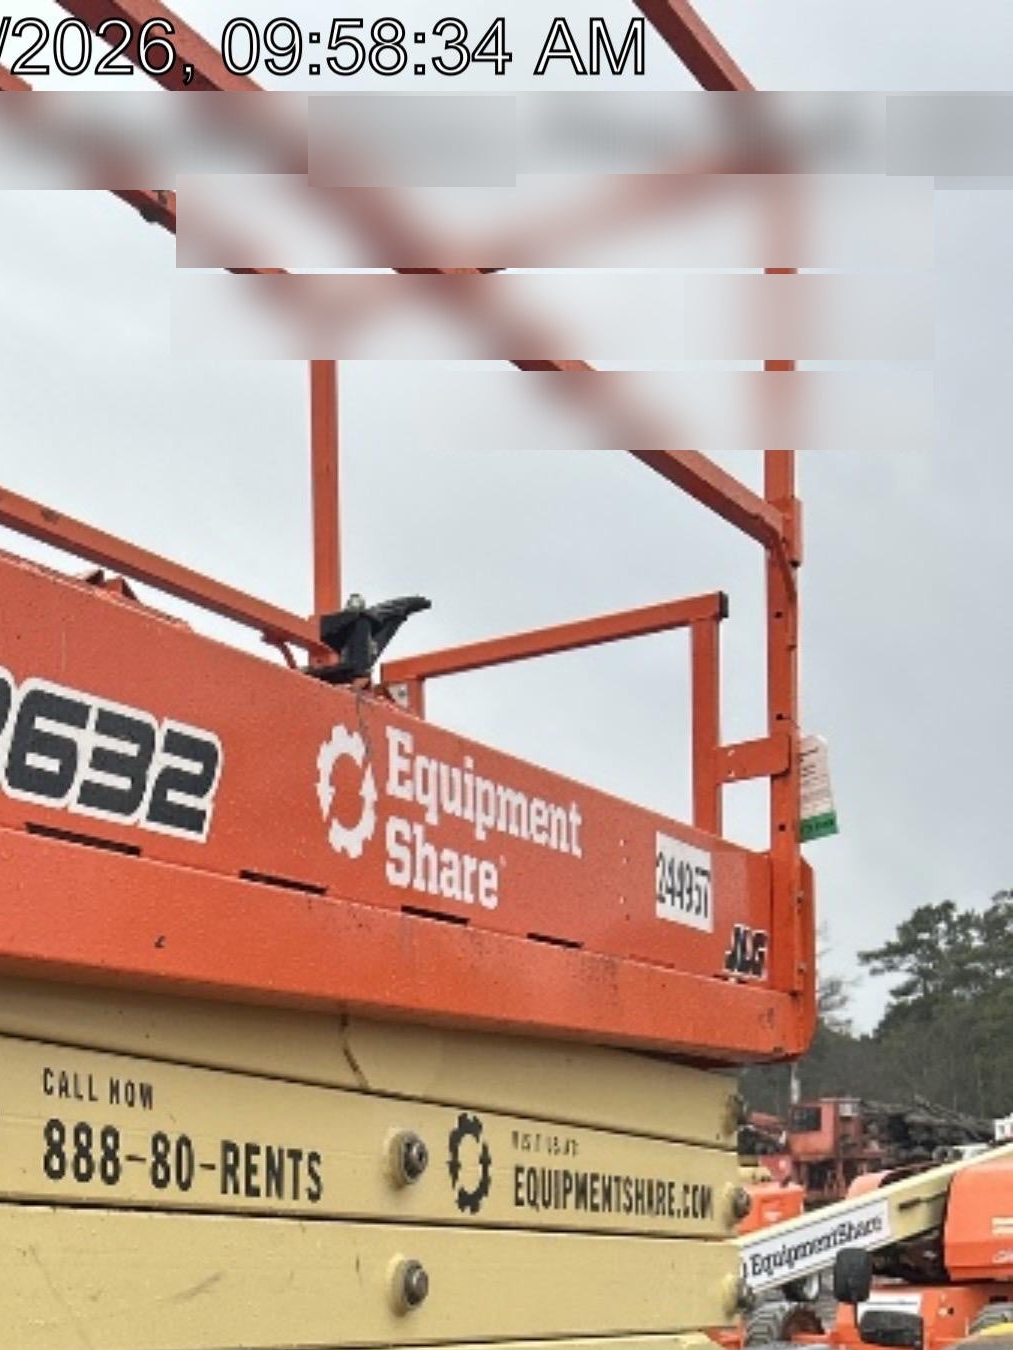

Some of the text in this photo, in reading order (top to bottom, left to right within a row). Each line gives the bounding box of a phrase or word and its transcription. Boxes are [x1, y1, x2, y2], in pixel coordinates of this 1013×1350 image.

[385, 726, 583, 859] Equipment
[385, 815, 498, 910] Share
[723, 922, 770, 980] JLG
[43, 1067, 154, 1110] CALL NOW
[43, 1118, 323, 1203] 888-80-RENTS
[514, 1165, 715, 1221] EQUIPMENTSHARE.COM
[749, 1215, 882, 1277] EquipmentShare
